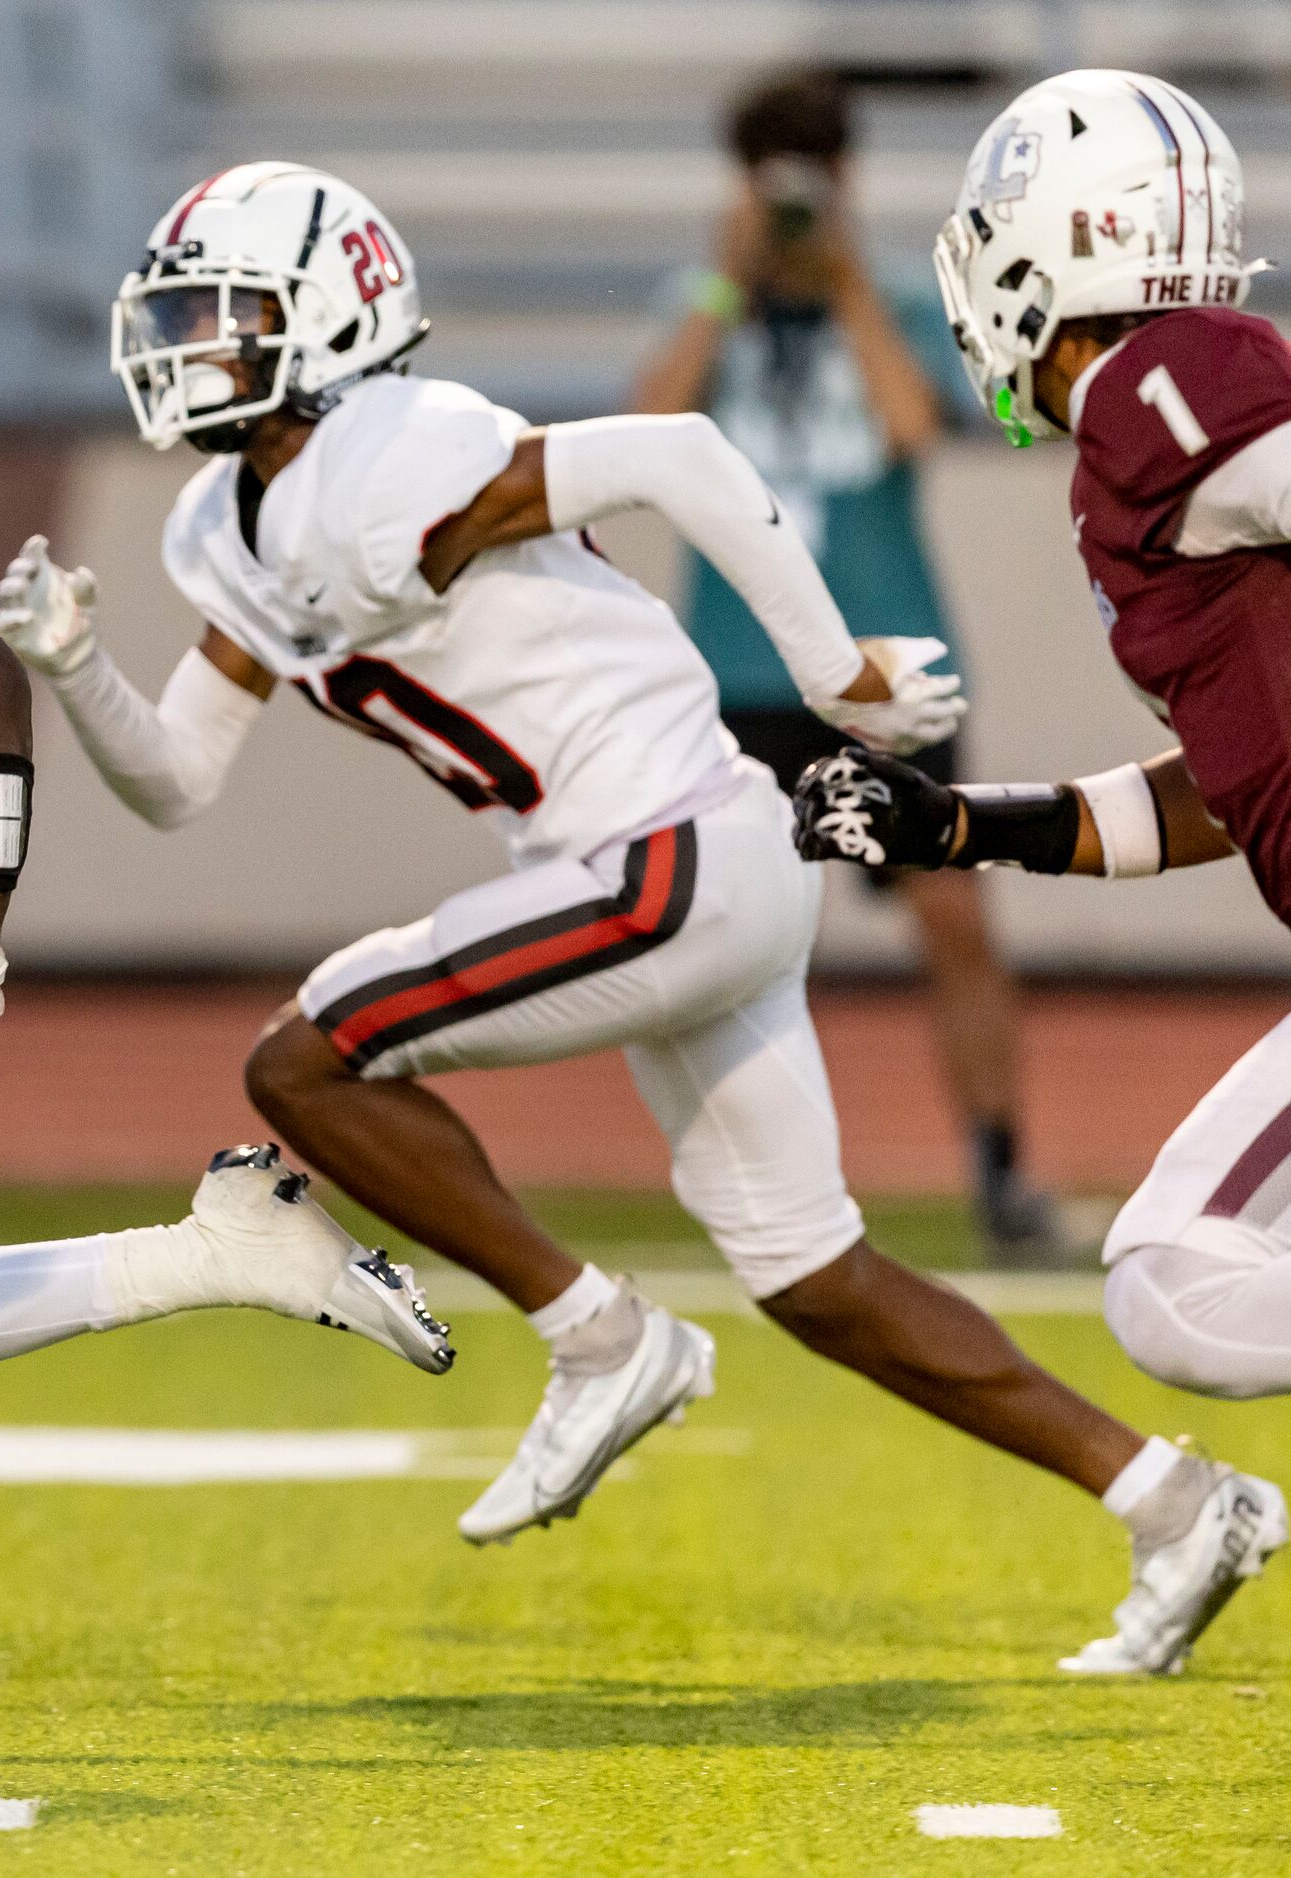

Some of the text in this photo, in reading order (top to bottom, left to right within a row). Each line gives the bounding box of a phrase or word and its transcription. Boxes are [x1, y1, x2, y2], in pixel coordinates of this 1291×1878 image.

[341, 220, 404, 304] 20
[1141, 274, 1193, 304] THE
[1137, 363, 1211, 458] 1
